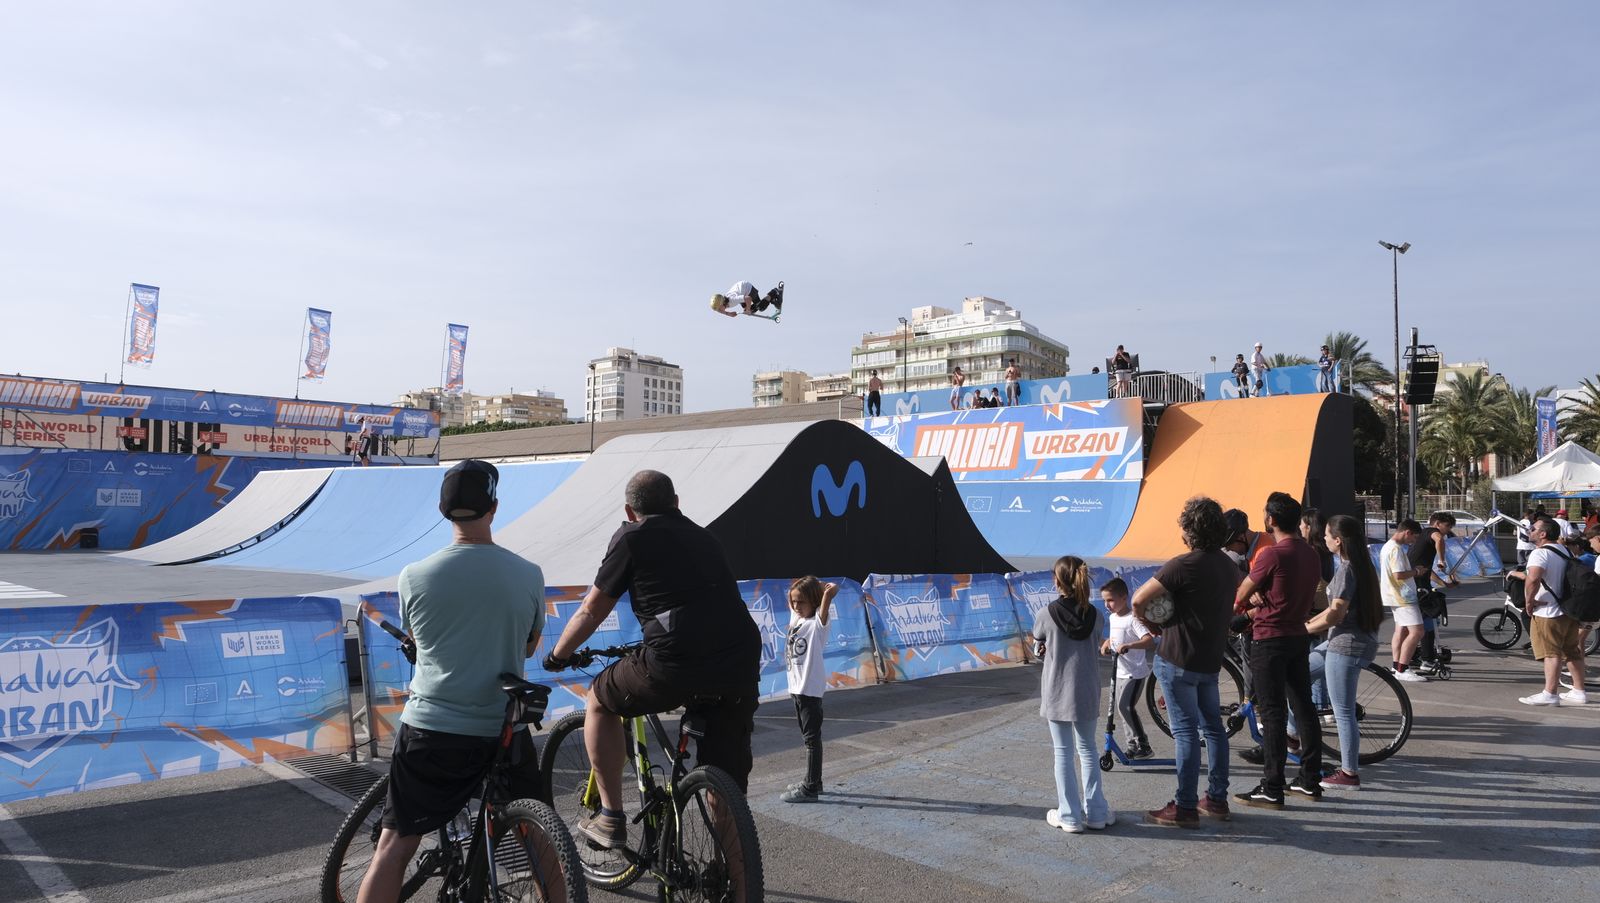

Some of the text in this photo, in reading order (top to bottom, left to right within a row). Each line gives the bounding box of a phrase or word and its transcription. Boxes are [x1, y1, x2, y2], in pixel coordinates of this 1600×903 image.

[0, 380, 146, 409] NDALUCÍA URBAN
[277, 403, 391, 427] ANDALUCÍA UBAN
[16, 431, 66, 442] SERIES
[41, 421, 98, 433] WORLD
[244, 433, 332, 446] URBAN WORLD
[268, 443, 308, 454] SERIES
[916, 422, 1018, 468] ANDALUCÍA
[1032, 432, 1120, 455] URBAN
[887, 604, 945, 627] Andalucía
[903, 630, 945, 648] URBAN
[0, 698, 99, 738] BAN
